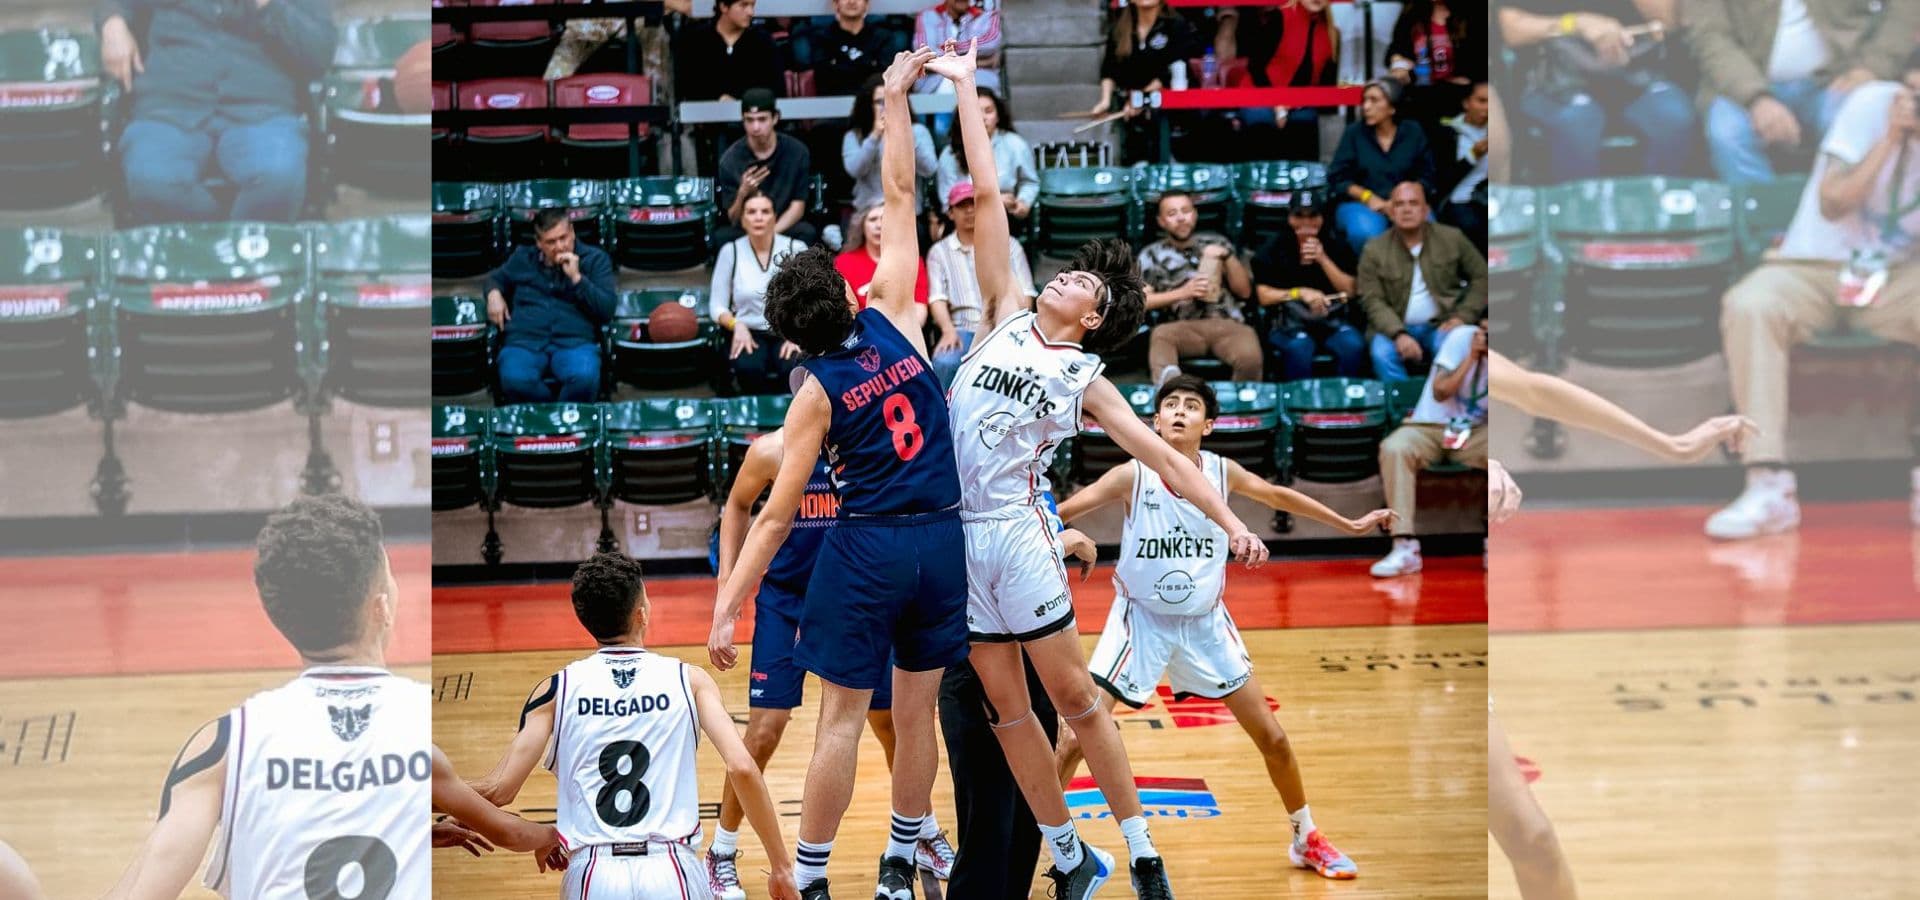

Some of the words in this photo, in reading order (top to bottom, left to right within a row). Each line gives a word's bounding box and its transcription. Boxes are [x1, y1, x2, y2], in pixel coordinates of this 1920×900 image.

[842, 355, 924, 412] SEPULVEDA
[972, 365, 1056, 419] ZONKEYS
[883, 393, 924, 461] 8
[1136, 537, 1213, 559] ZONKEYS
[1154, 583, 1196, 592] NISSAN
[577, 693, 670, 717] DELGADO
[266, 751, 432, 792] DELGADO
[595, 741, 650, 828] 8
